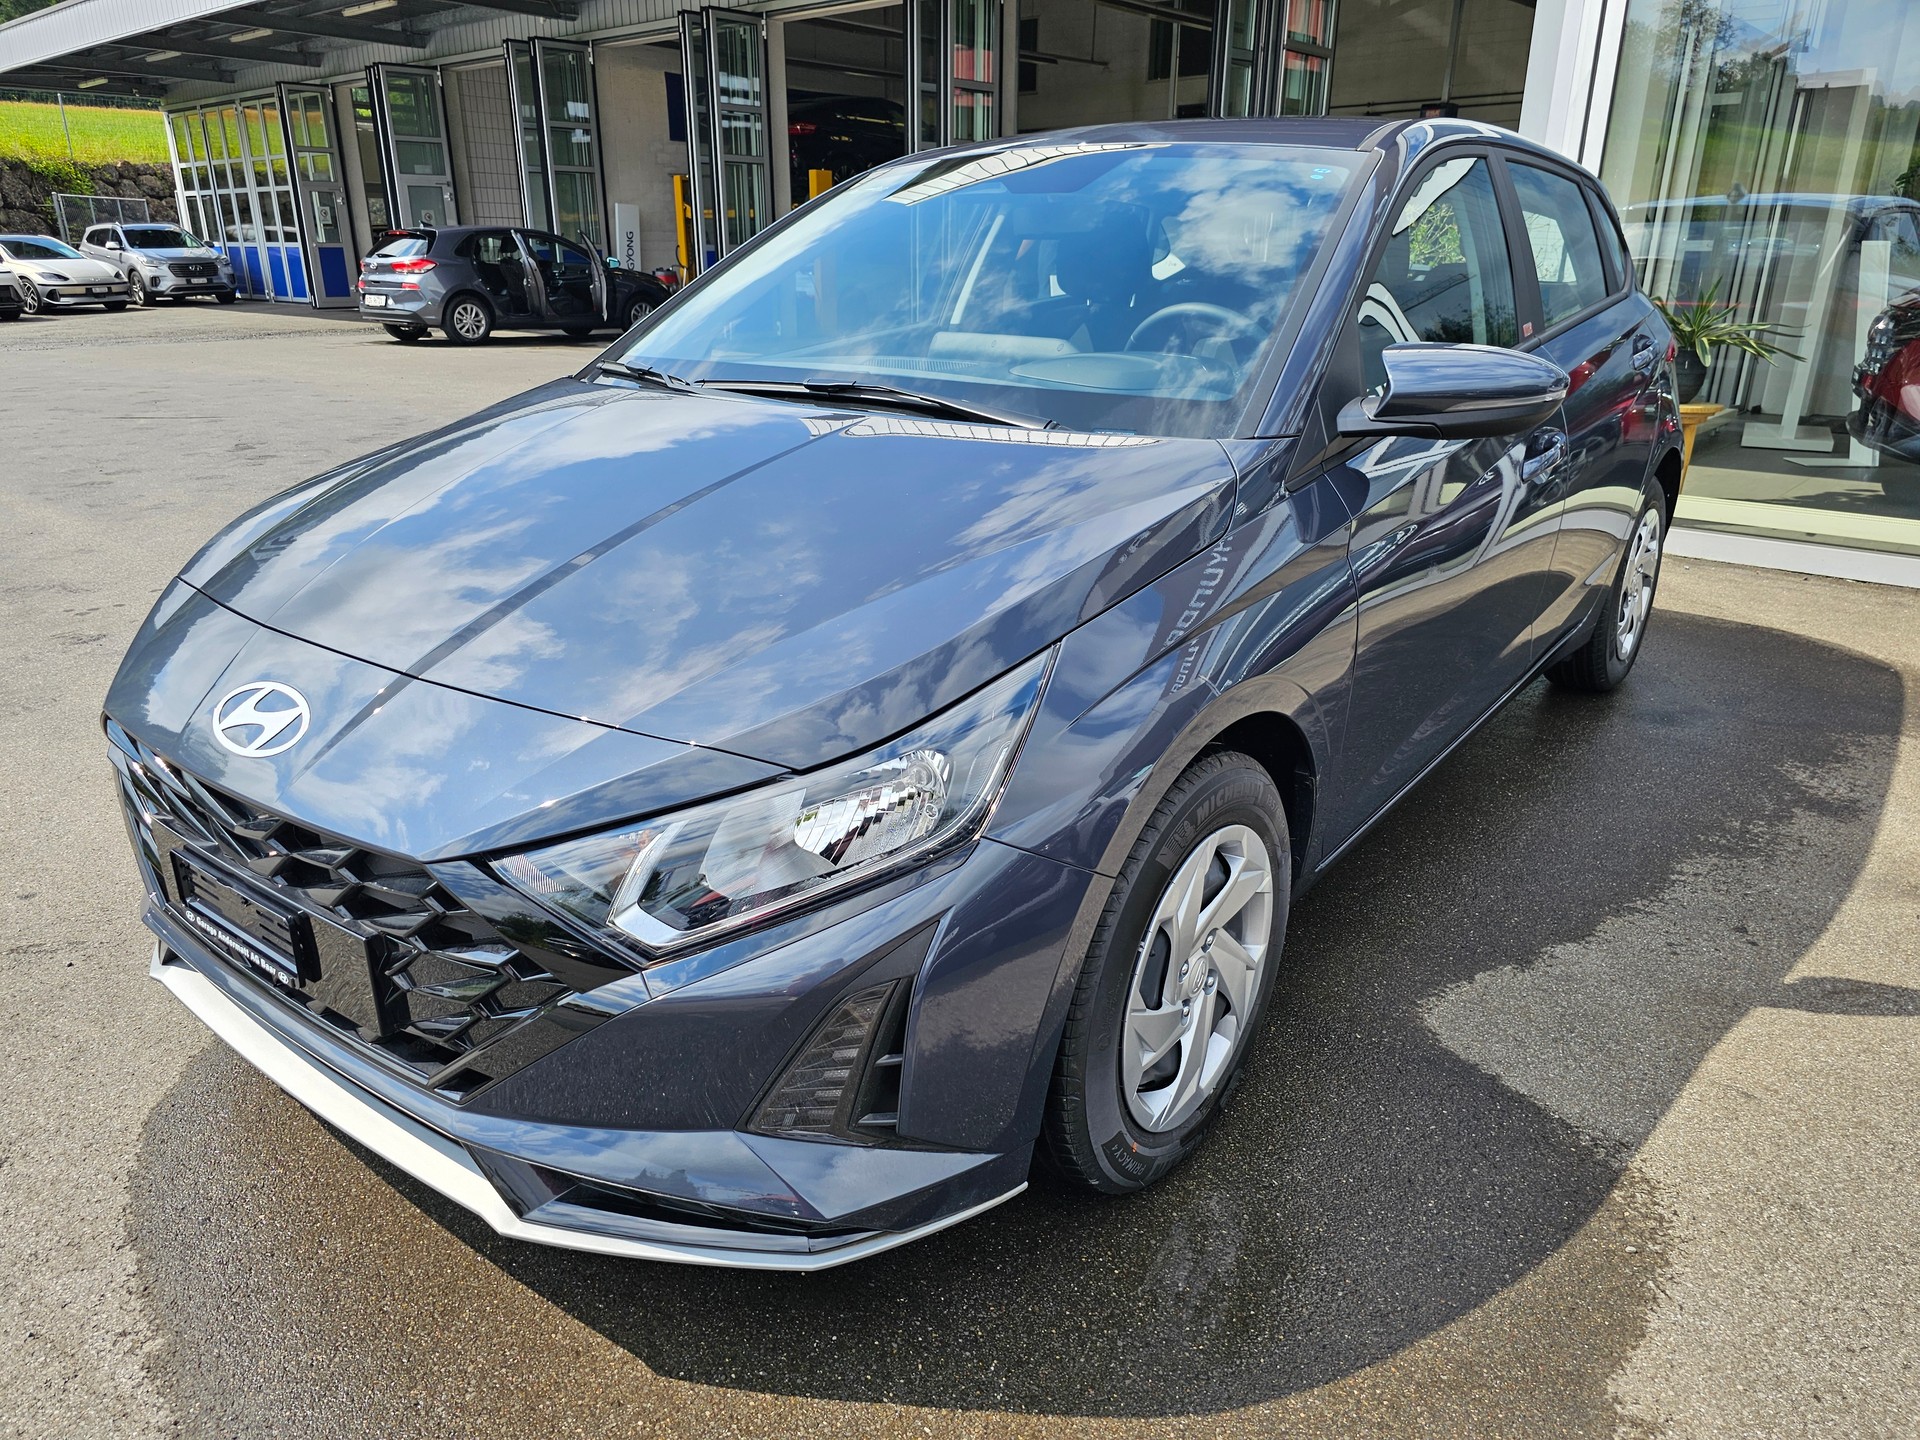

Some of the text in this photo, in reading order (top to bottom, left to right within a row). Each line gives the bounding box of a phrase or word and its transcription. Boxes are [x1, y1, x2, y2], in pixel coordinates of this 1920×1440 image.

[196, 916, 217, 937] Garage
[250, 952, 260, 965] AG
[1113, 1147, 1147, 1176] PRIMACY
